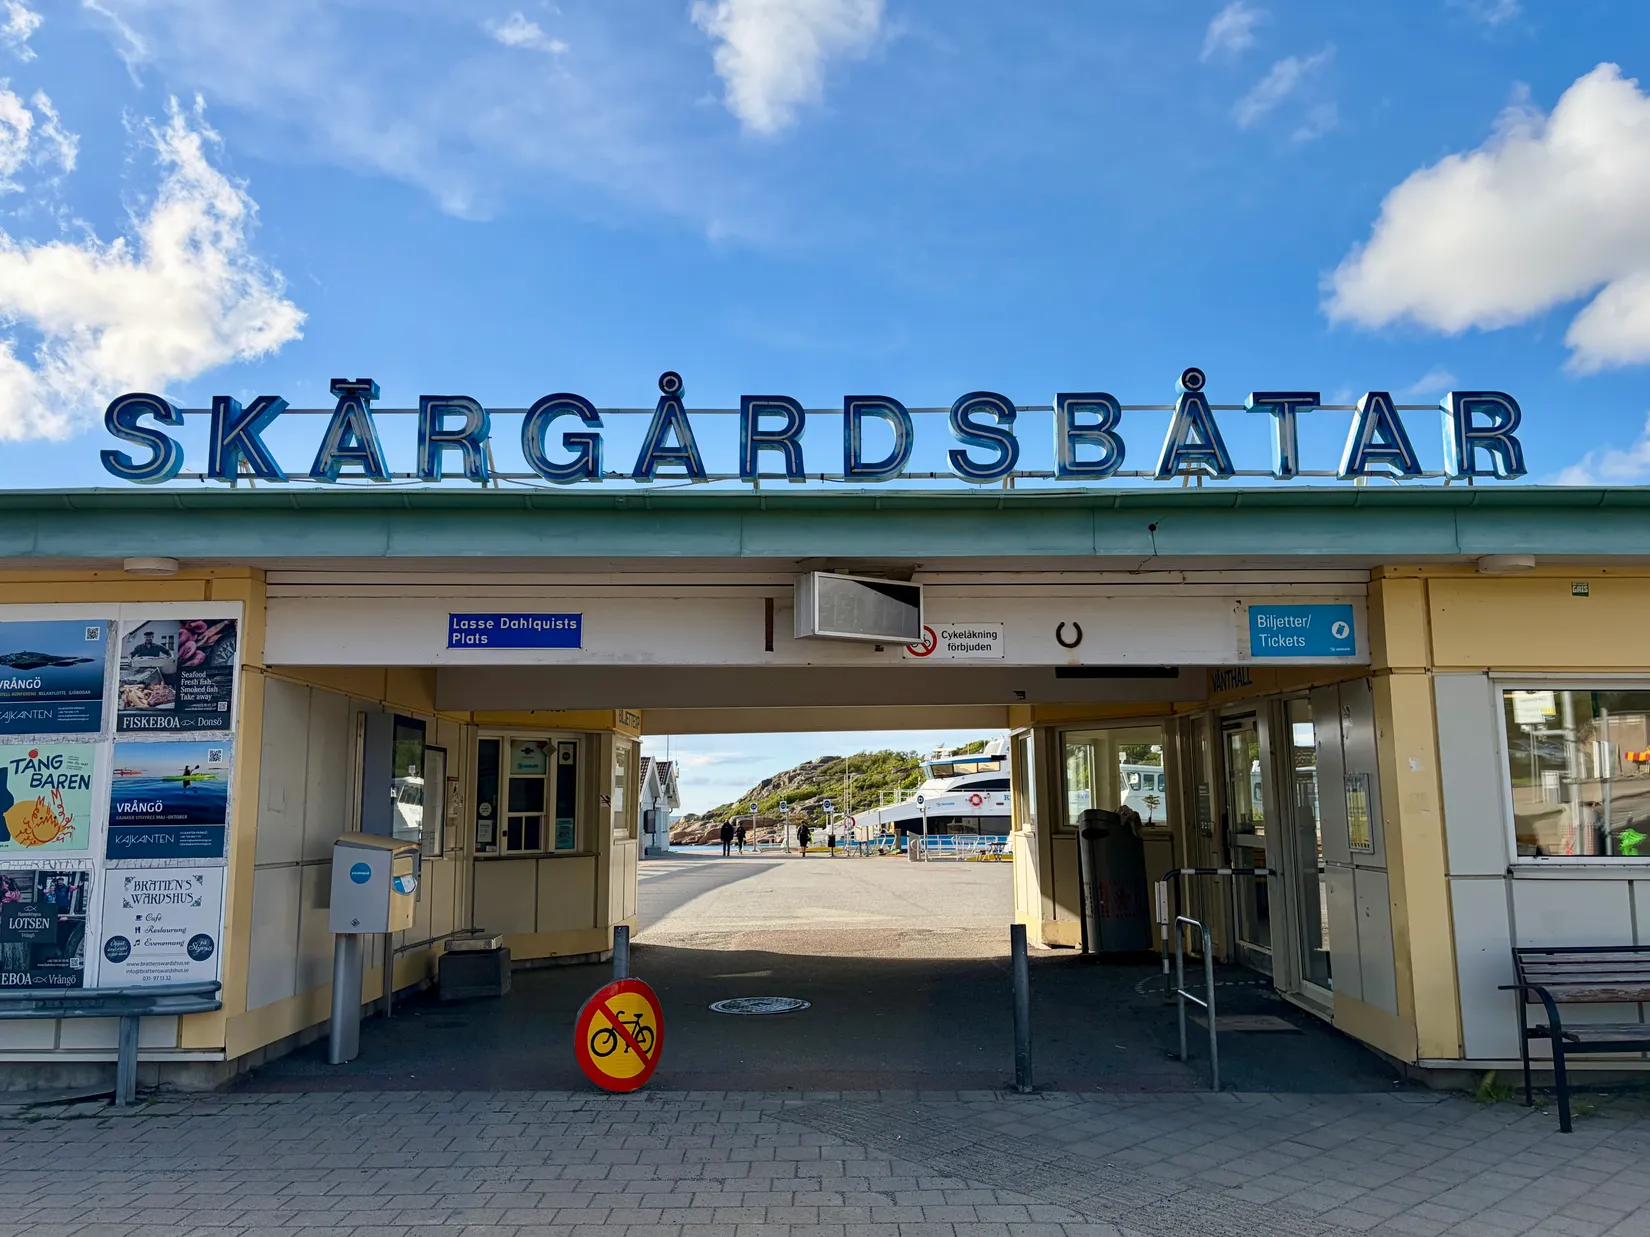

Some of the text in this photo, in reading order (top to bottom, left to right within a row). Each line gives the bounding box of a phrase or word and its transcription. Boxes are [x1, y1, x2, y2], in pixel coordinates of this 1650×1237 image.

[100, 367, 1528, 485] SKÄRGÅRDSBÅTAR
[1573, 585, 1588, 593] GAIS
[453, 618, 577, 631] Lasse Dahlquists
[1257, 614, 1312, 630] Biljetter/
[452, 633, 488, 644] Plats
[941, 630, 998, 641] Cykelåkning
[1259, 634, 1306, 647] Tickets
[947, 642, 992, 653] förbjuden
[123, 716, 222, 729] FISKEBOA Donsö
[10, 748, 63, 775] TÅNG
[30, 773, 91, 790] BAREN
[116, 800, 163, 812] VRÅNGÖ
[115, 833, 175, 848] KAJKANTEN
[9, 917, 50, 929] LOTSEN
[145, 913, 162, 922] Café
[144, 925, 187, 934] Restaurang
[144, 938, 186, 947] Evenemang
[0, 973, 76, 986] EBOA Vrångö
